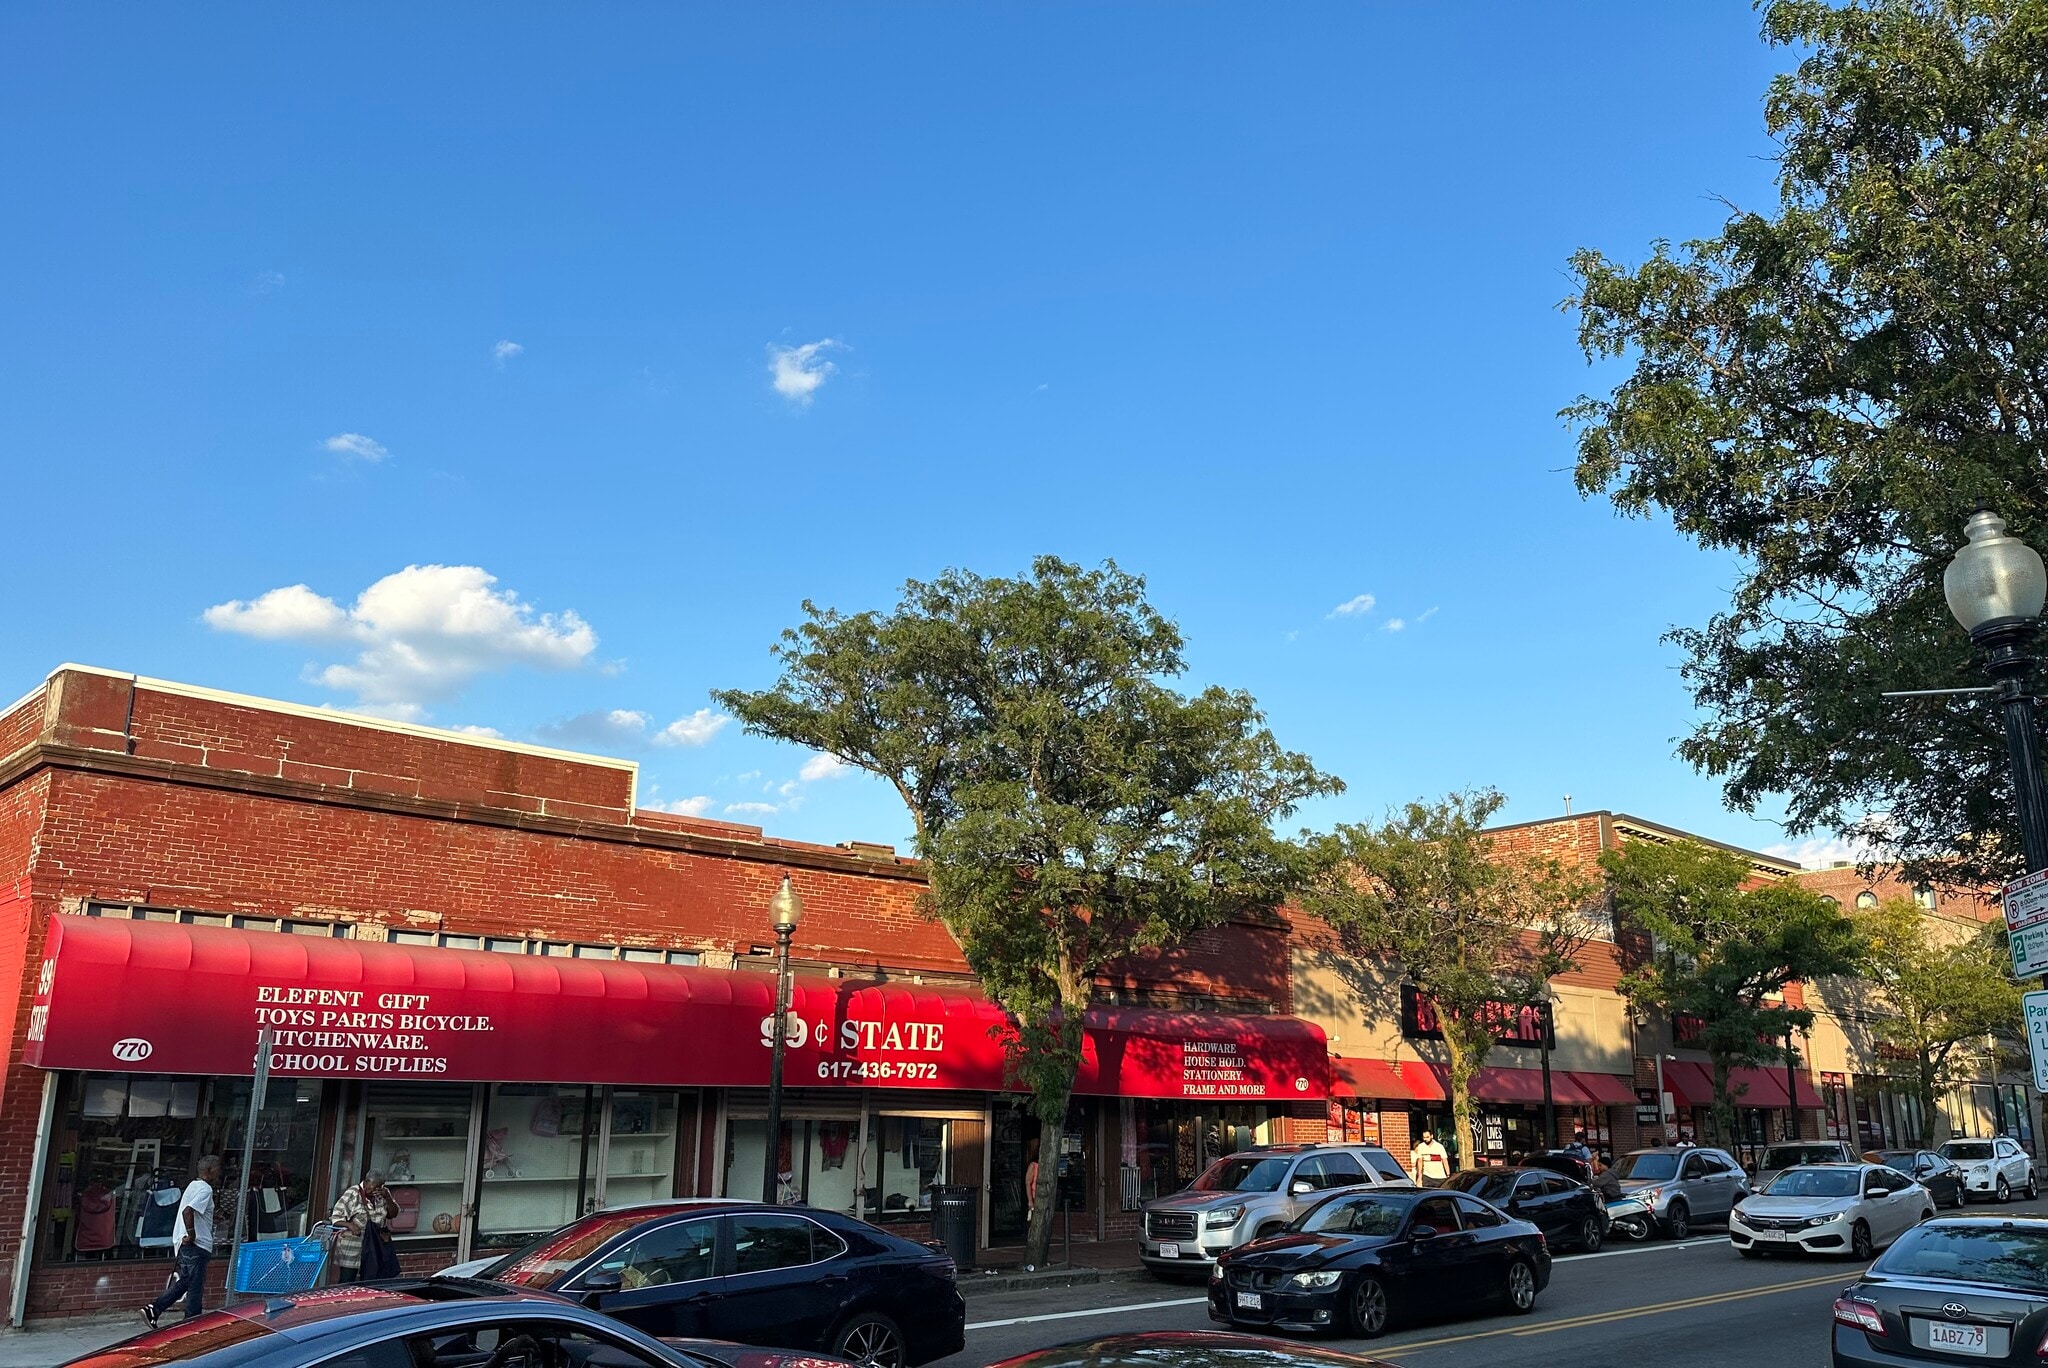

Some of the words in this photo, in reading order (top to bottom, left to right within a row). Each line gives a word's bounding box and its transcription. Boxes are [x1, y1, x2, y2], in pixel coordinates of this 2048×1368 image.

[2015, 914, 2036, 929] LOADING
[2024, 930, 2044, 941] Parking
[2015, 940, 2024, 955] 2
[38, 958, 54, 995] 99
[256, 986, 363, 1007] ELEFENT
[378, 993, 429, 1010] GIFT
[2028, 1003, 2048, 1017] Par
[254, 1008, 316, 1026] TOYS
[321, 1011, 394, 1029] PARTS
[399, 1014, 494, 1031] BICYCLE.
[2033, 1021, 2042, 1033] 2
[840, 1020, 944, 1051] STATE
[116, 1042, 149, 1057] 770
[1184, 1041, 1236, 1054] HARDWARE
[355, 1056, 447, 1073] SUPLIES
[1184, 1056, 1217, 1067] HOUSE
[1219, 1057, 1246, 1068] HOLD.
[817, 1061, 937, 1079] 617-436-7972
[1183, 1069, 1244, 1081] STATIONERY.
[1183, 1084, 1216, 1095] FRAME
[1218, 1084, 1237, 1095] AND
[1239, 1084, 1266, 1095] MORE
[1296, 1080, 1308, 1089] 770
[1486, 1126, 1502, 1139] LIVES
[1665, 1129, 1678, 1138] FISH
[1487, 1140, 1503, 1149] MATTER
[1853, 1295, 1878, 1304] Camry
[1933, 1328, 1964, 1344] 1ABZ
[1968, 1332, 1983, 1346] 79
